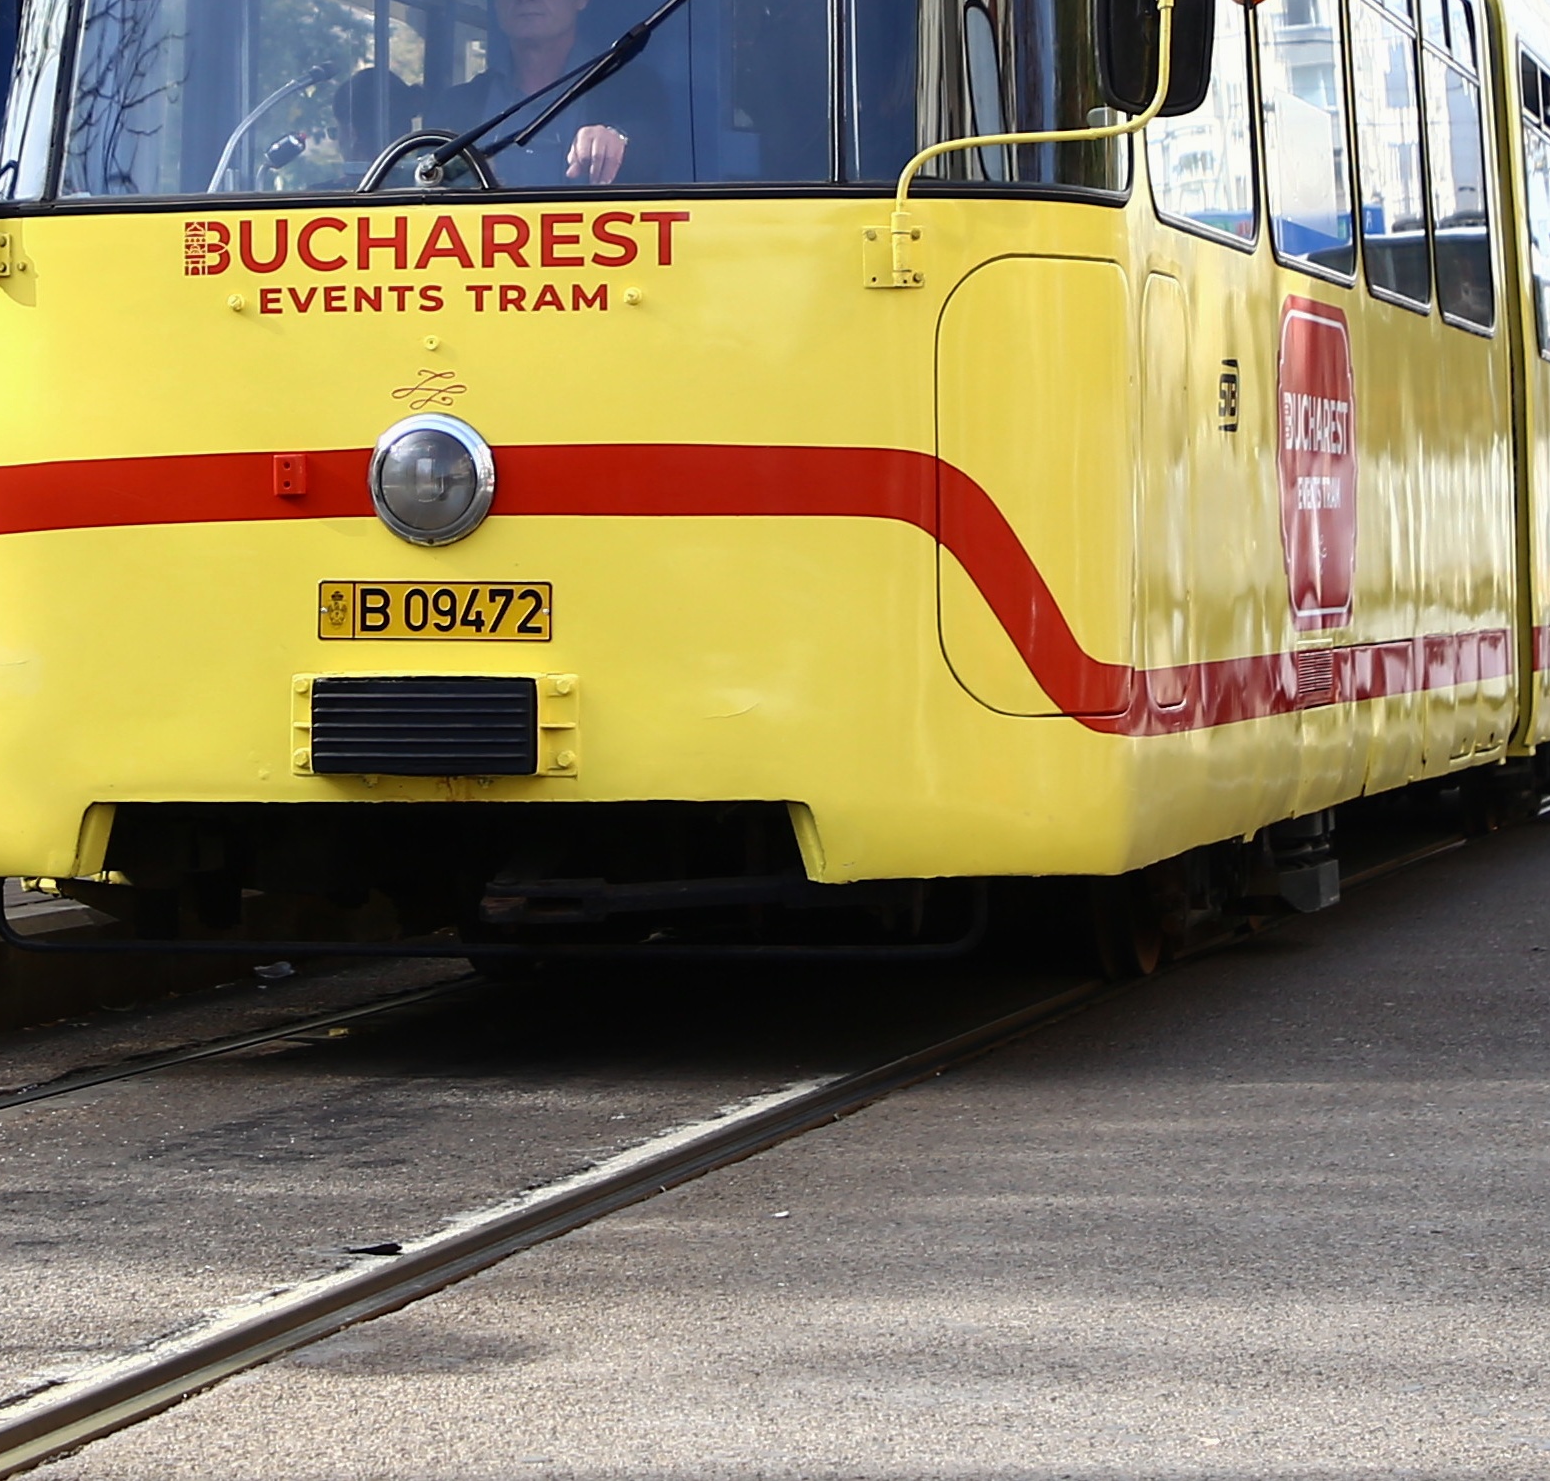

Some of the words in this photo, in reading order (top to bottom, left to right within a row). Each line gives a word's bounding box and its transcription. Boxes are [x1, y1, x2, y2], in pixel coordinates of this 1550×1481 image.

[183, 210, 690, 276] BUCHAREST
[259, 284, 444, 315] EVENTS
[466, 283, 609, 312] TRAM
[1284, 392, 1349, 455] BUCHAREST
[359, 589, 391, 631] B
[403, 588, 543, 634] 09472
